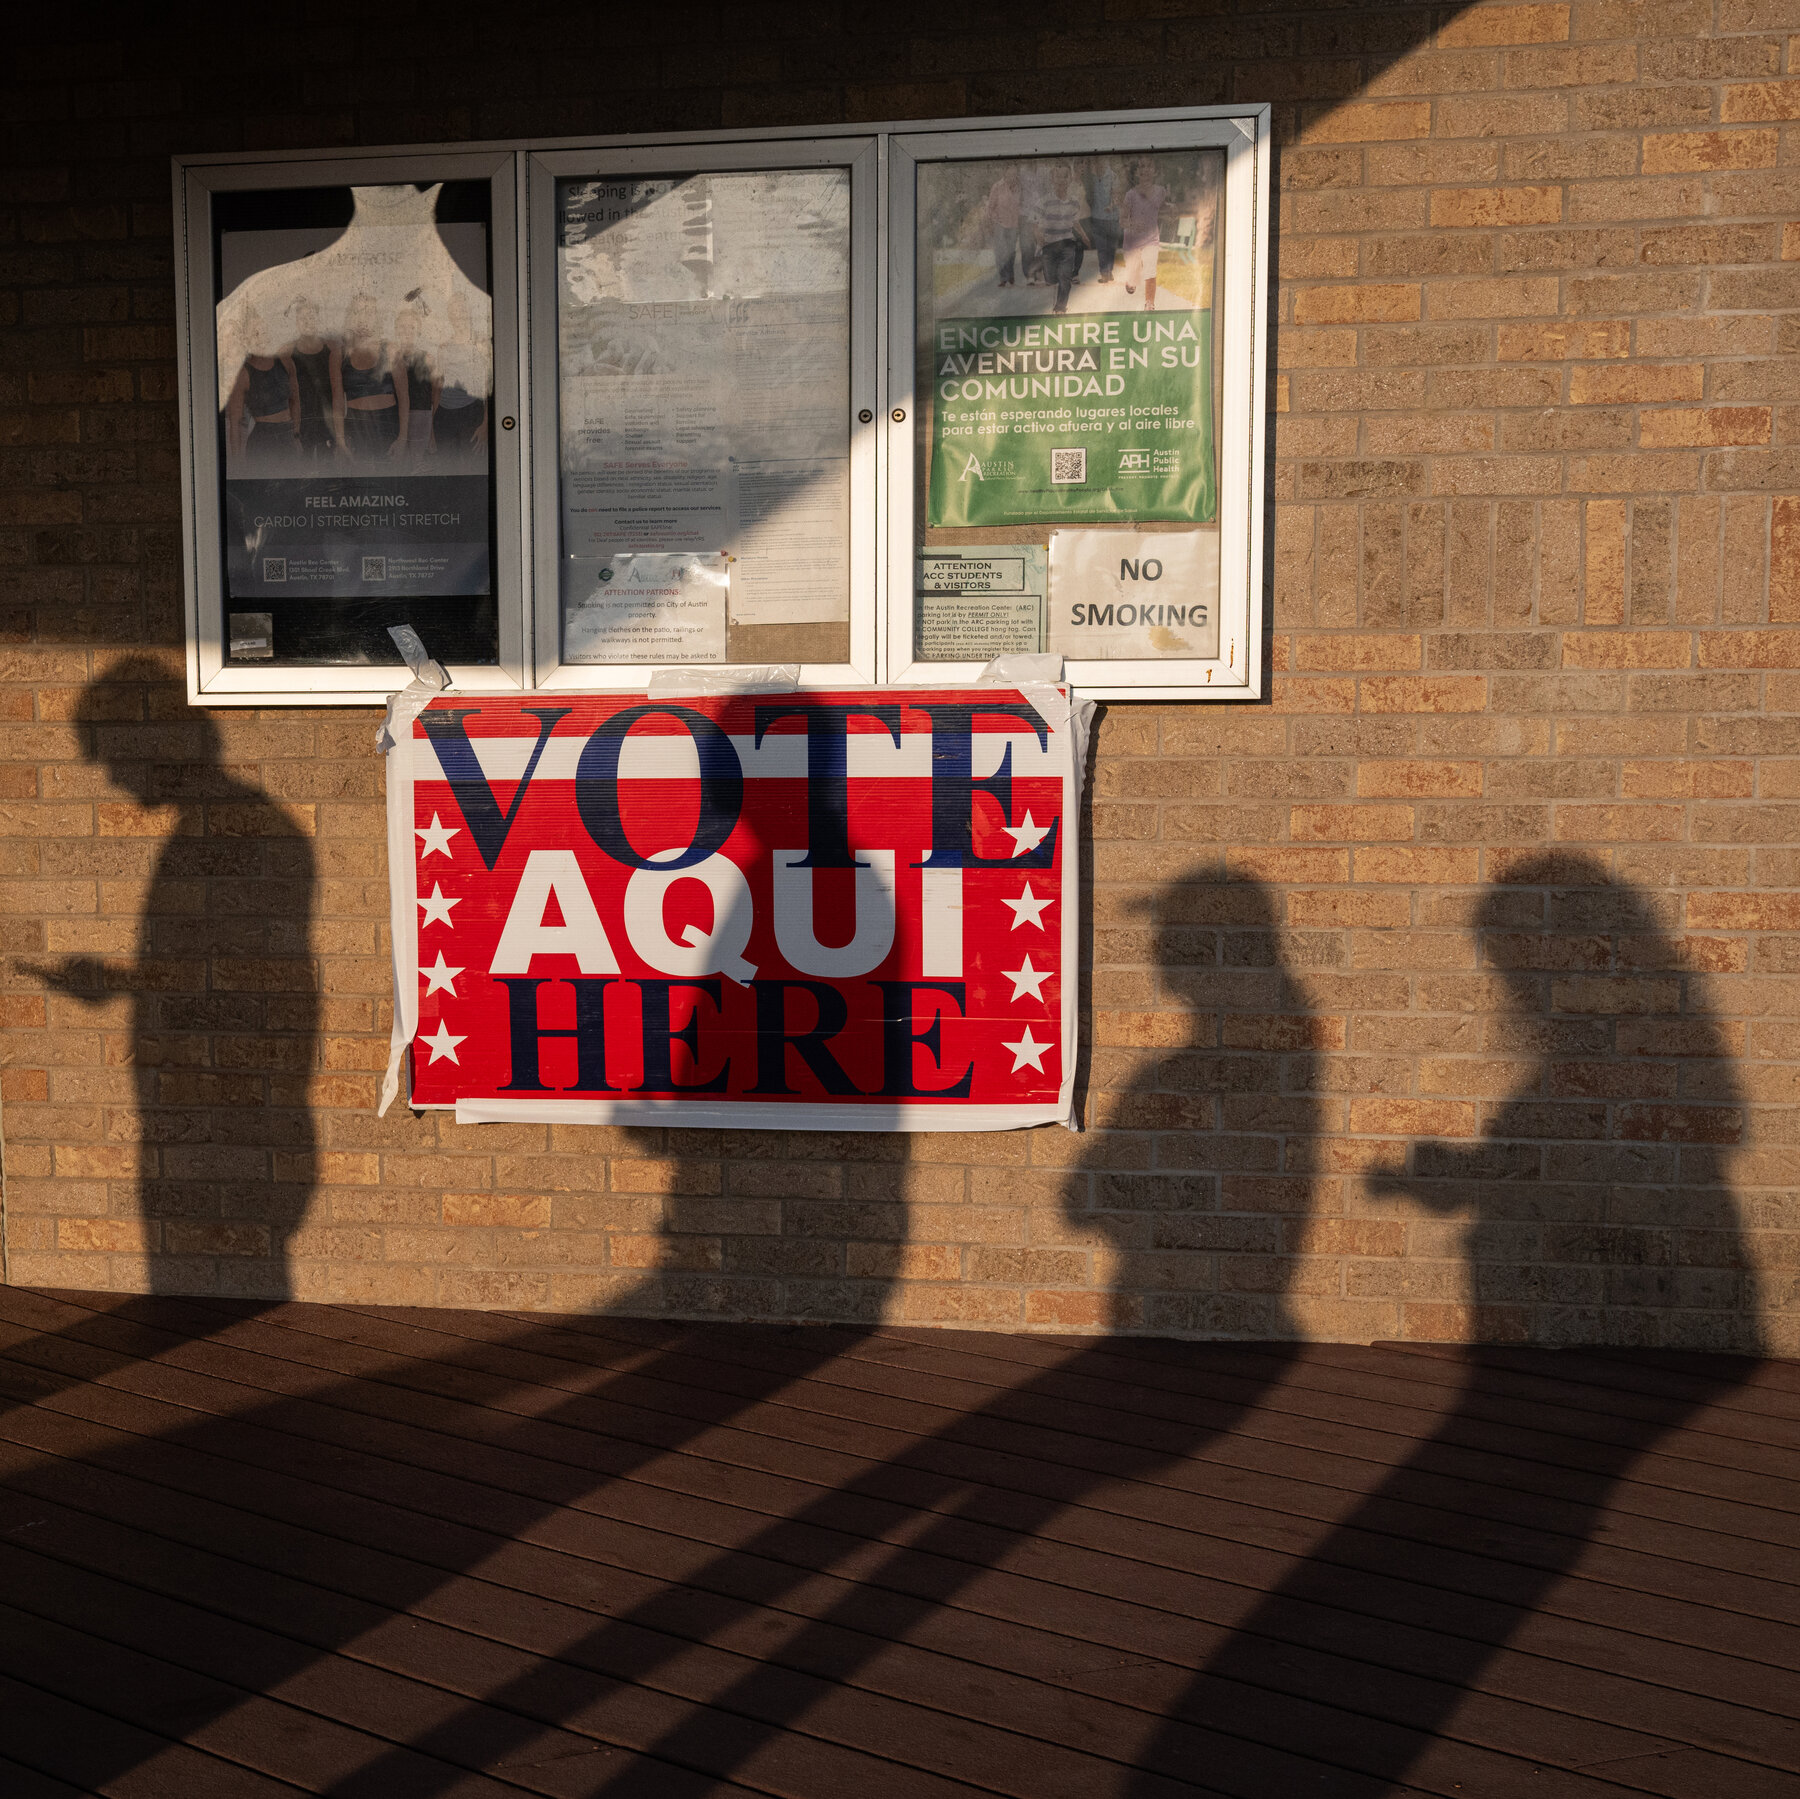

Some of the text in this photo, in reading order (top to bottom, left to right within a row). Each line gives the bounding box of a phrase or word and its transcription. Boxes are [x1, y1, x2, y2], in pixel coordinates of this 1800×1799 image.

[608, 209, 620, 221] in
[629, 304, 673, 319] SAFE
[940, 320, 1199, 350] ENCUENTRE UNA
[940, 345, 1201, 376] AVENTURA EN SU
[940, 374, 1126, 401] COMUNIDAD
[942, 403, 1179, 424] Te están esperando lugares locales
[942, 417, 1195, 438] para estar activo afuera y al aire libre
[603, 461, 623, 469] SAFE
[981, 460, 1015, 469] AUSTIN
[1119, 454, 1150, 469] APH
[1153, 456, 1180, 464] Public
[1153, 465, 1180, 473] Health
[305, 495, 409, 508] FEEL AMAZING.
[254, 512, 460, 528] CARDIO STRENGTH STRETCH
[933, 562, 992, 570] ATTENTION
[1120, 558, 1163, 582] NO
[923, 571, 1003, 580] ACC STUDENTS
[944, 581, 991, 589] VISITORS
[646, 588, 681, 596] PATRONS:
[577, 601, 604, 609] Smoking
[623, 601, 655, 609] permitted
[666, 601, 680, 609] City
[687, 600, 708, 608] Austin
[1015, 603, 1034, 612] (ARC)
[628, 611, 657, 619] property.
[958, 612, 966, 620] by
[1070, 603, 1208, 628] SMOKING
[985, 619, 1010, 627] parking
[582, 626, 607, 635] Hanging
[653, 626, 672, 634] patio,
[673, 626, 695, 634] railings
[601, 636, 631, 645] walkways
[608, 652, 629, 660] violate
[630, 652, 648, 660] these
[649, 652, 665, 660] rules
[666, 653, 680, 662] may
[681, 652, 689, 660] be
[413, 703, 1060, 872] VOTE
[489, 848, 964, 989] AQUI
[494, 977, 975, 1099] HERE
